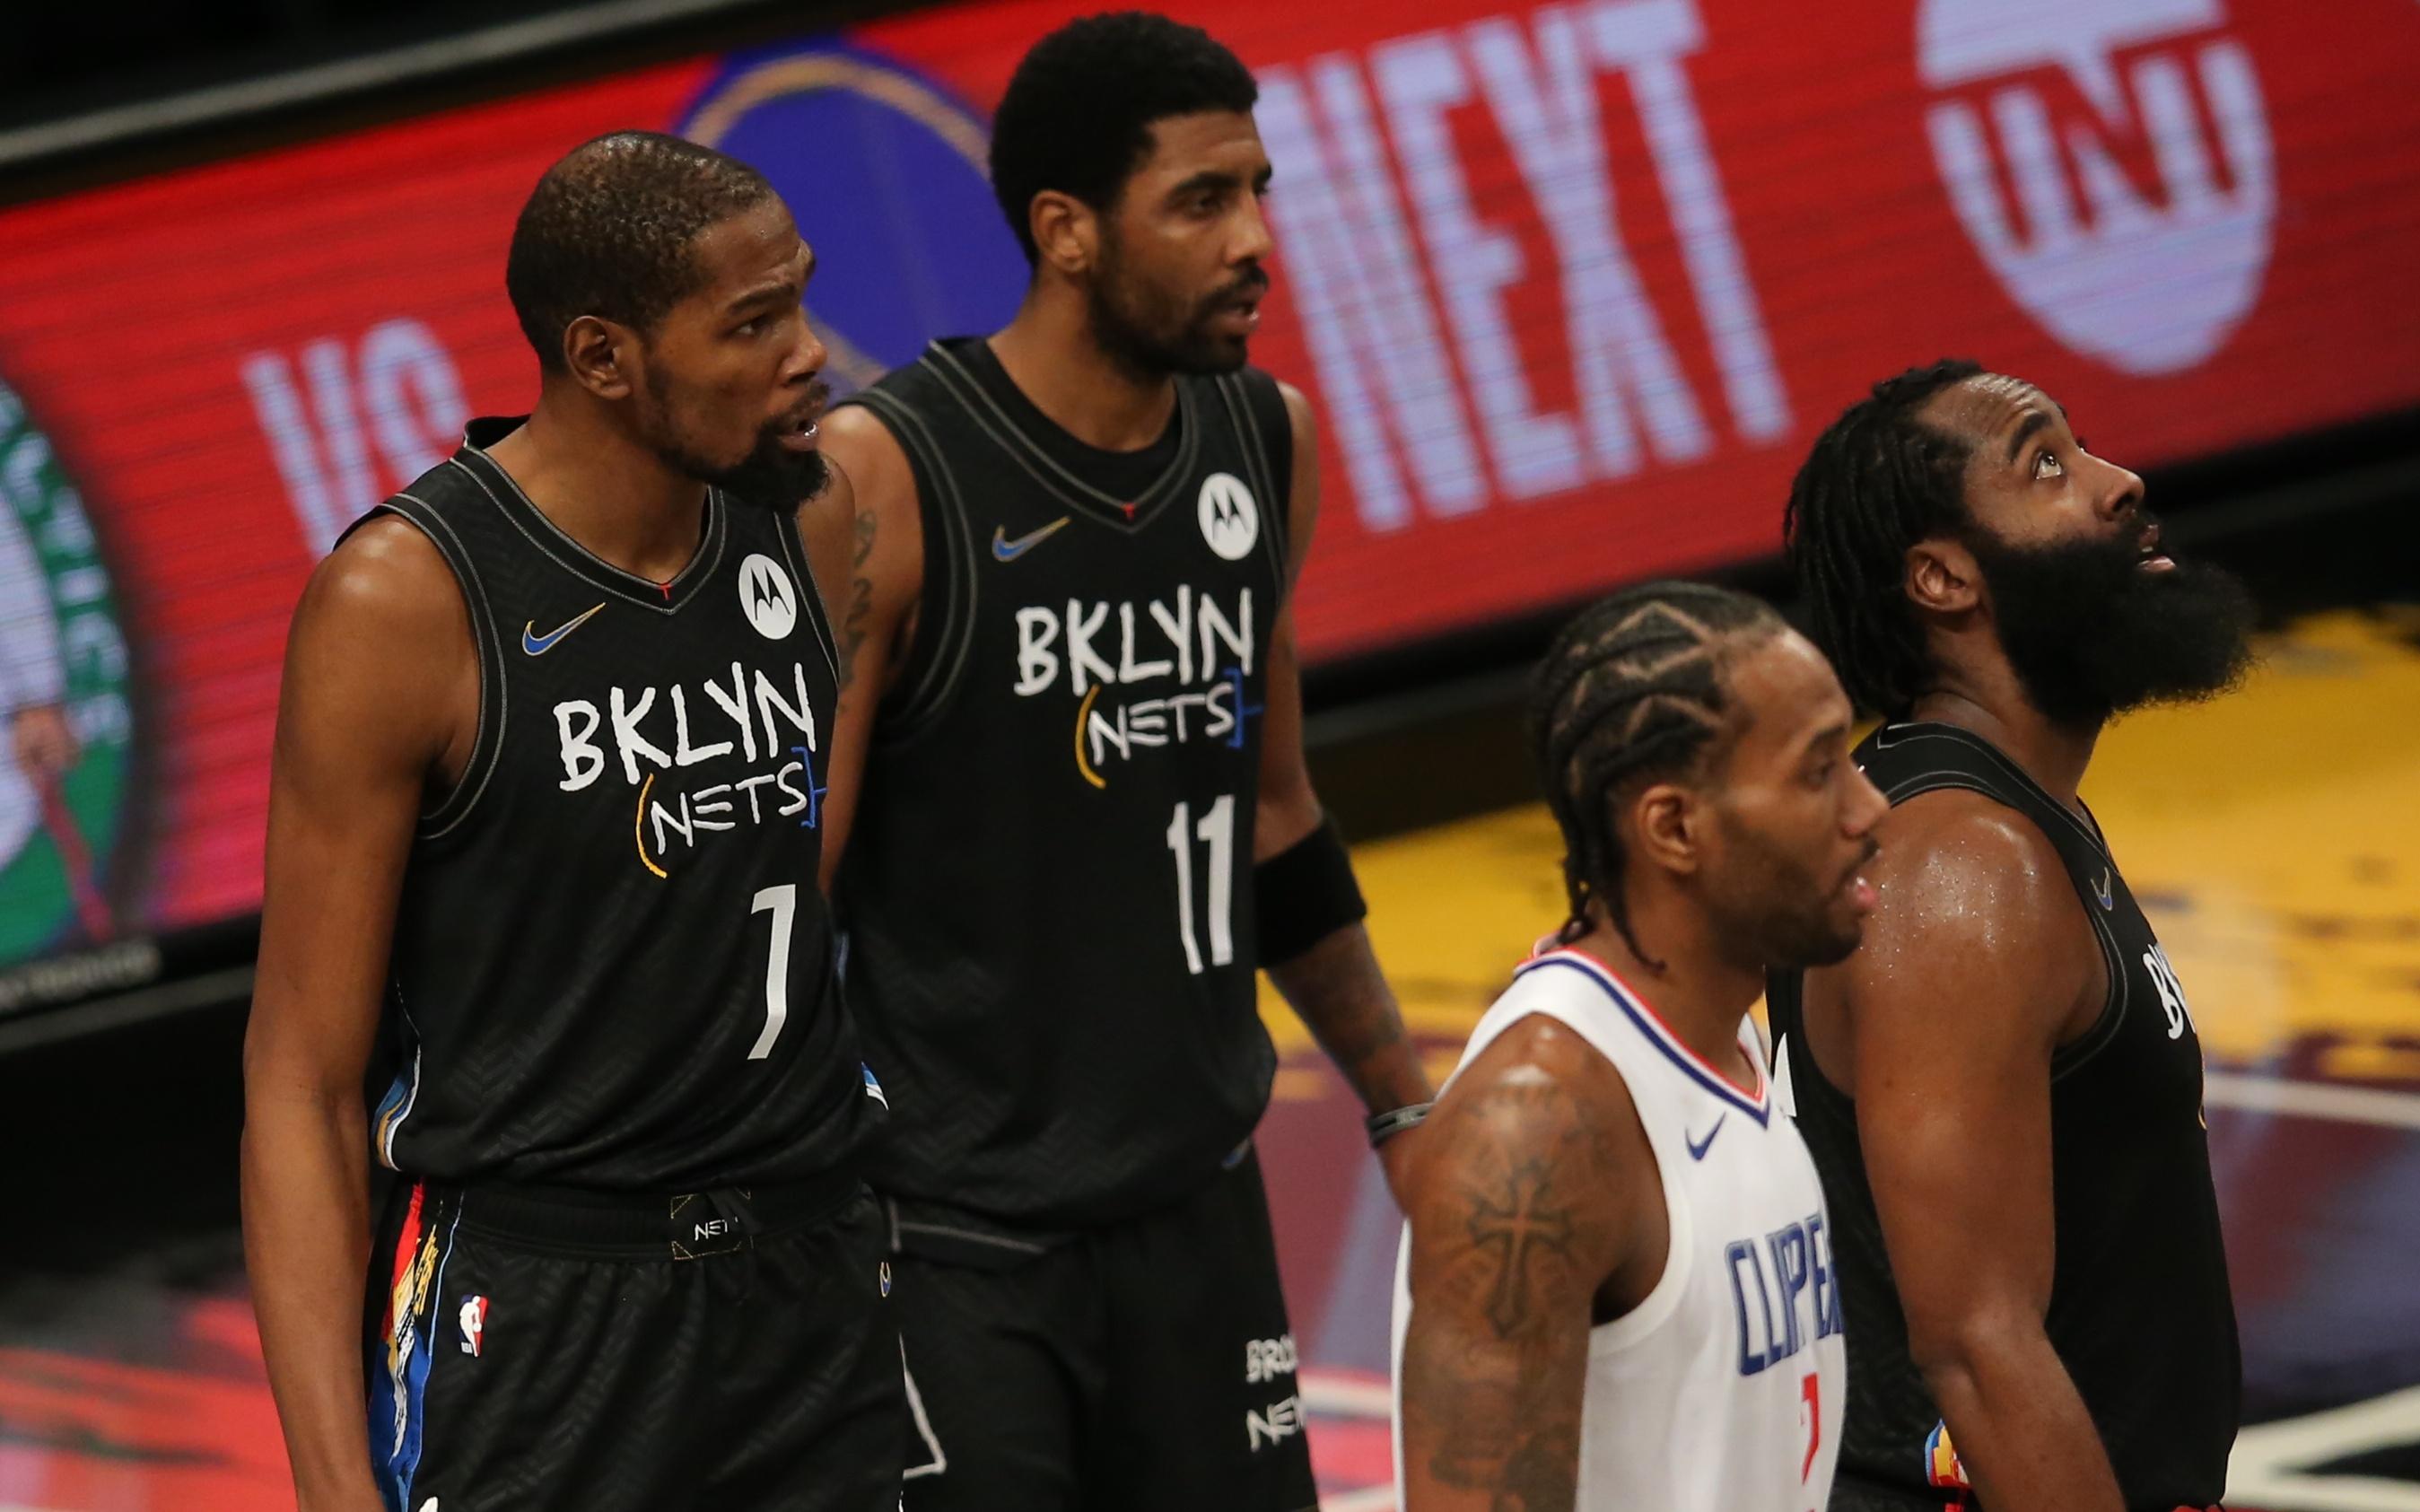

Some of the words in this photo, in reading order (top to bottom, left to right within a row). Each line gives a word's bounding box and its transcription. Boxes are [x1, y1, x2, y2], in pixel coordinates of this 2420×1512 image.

[1254, 0, 1789, 531] NEXT
[239, 319, 470, 558] VS
[1014, 584, 1254, 696] BKLYN
[553, 661, 816, 791] BKLYN
[1088, 681, 1235, 766] NETS
[651, 761, 808, 855] NETS
[1167, 794, 1235, 974] 11
[747, 884, 797, 1060] 7
